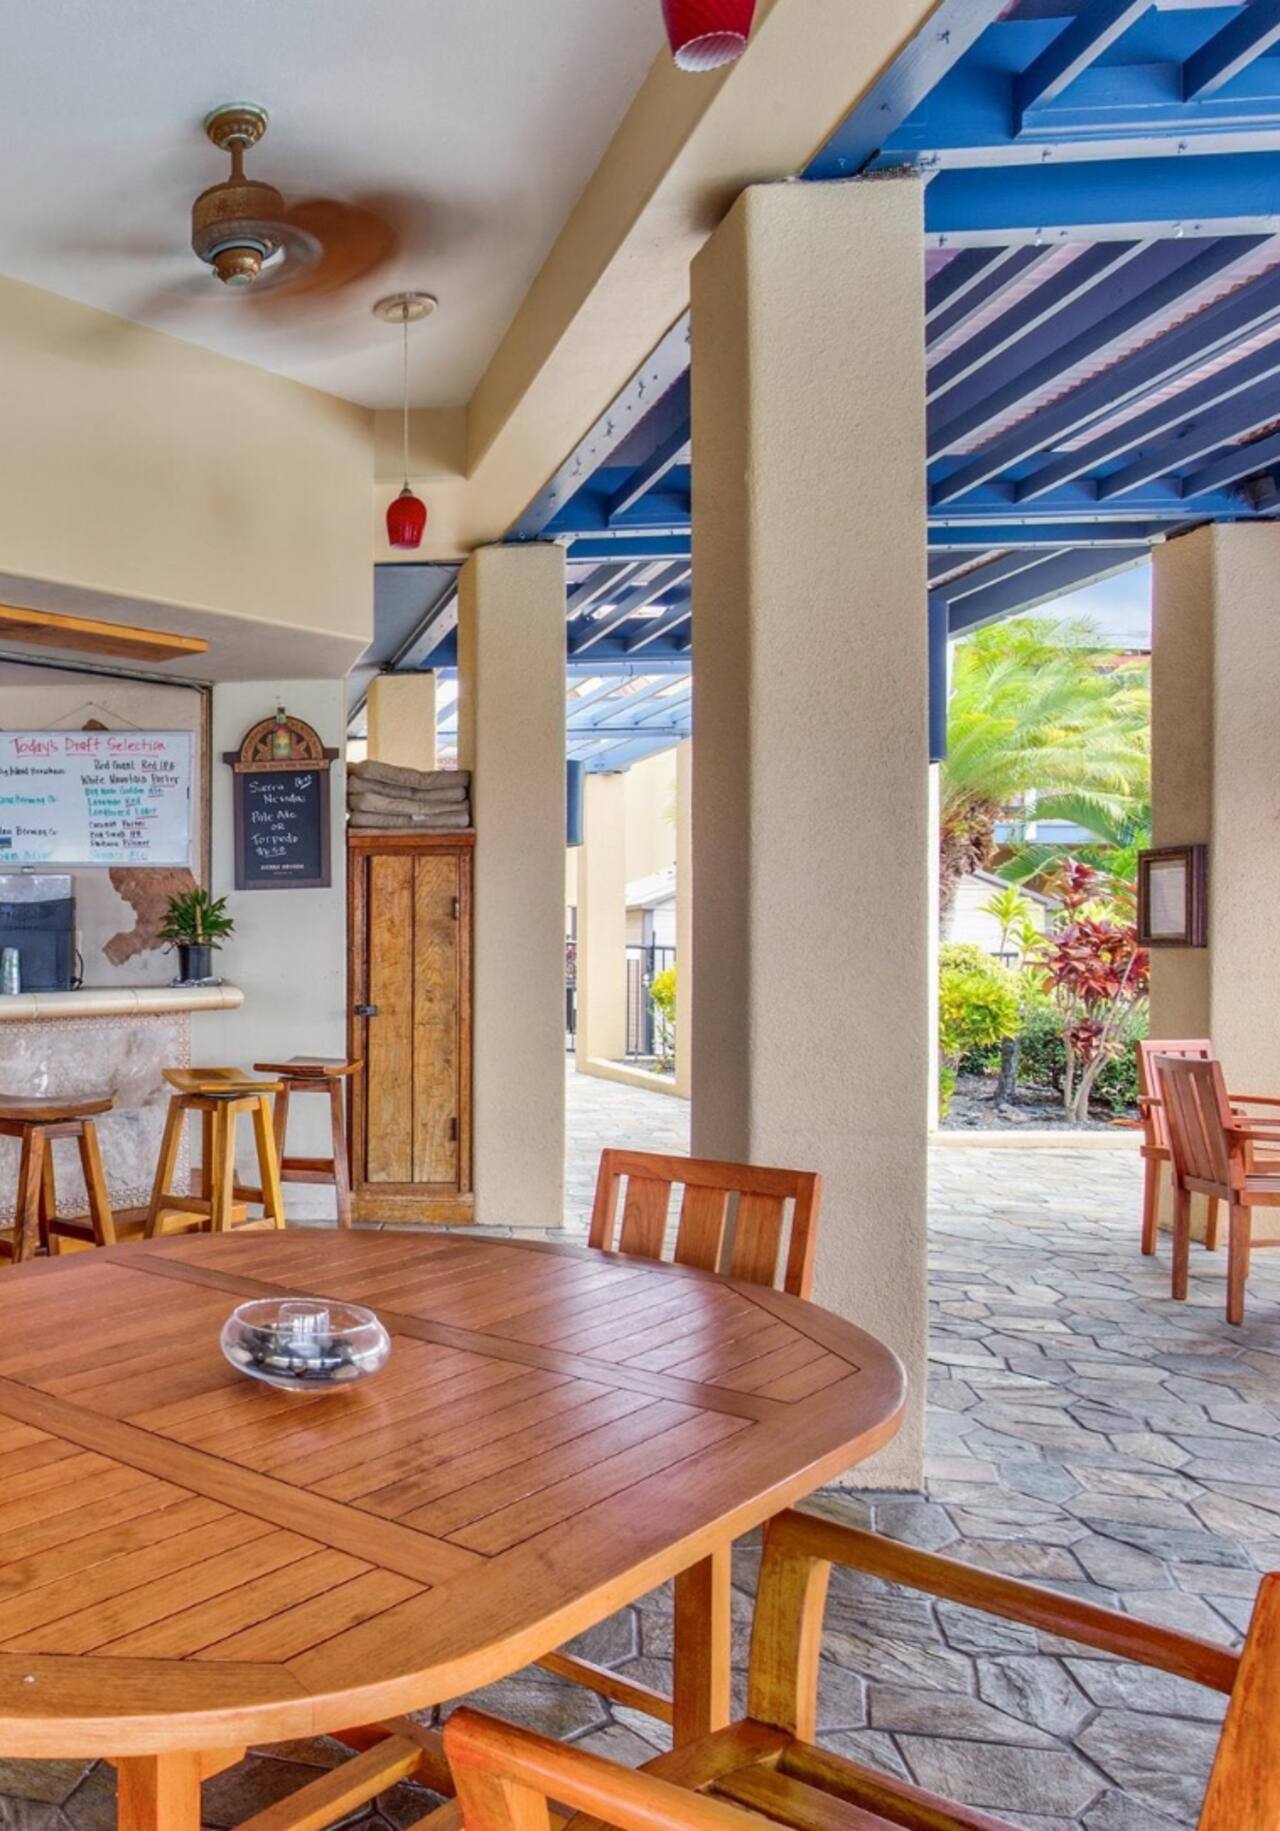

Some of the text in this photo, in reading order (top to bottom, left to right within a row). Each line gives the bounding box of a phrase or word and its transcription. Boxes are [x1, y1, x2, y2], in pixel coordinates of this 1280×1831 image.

[65, 737, 100, 751] Draft
[107, 737, 166, 751] Selection
[276, 809, 297, 819] Ale
